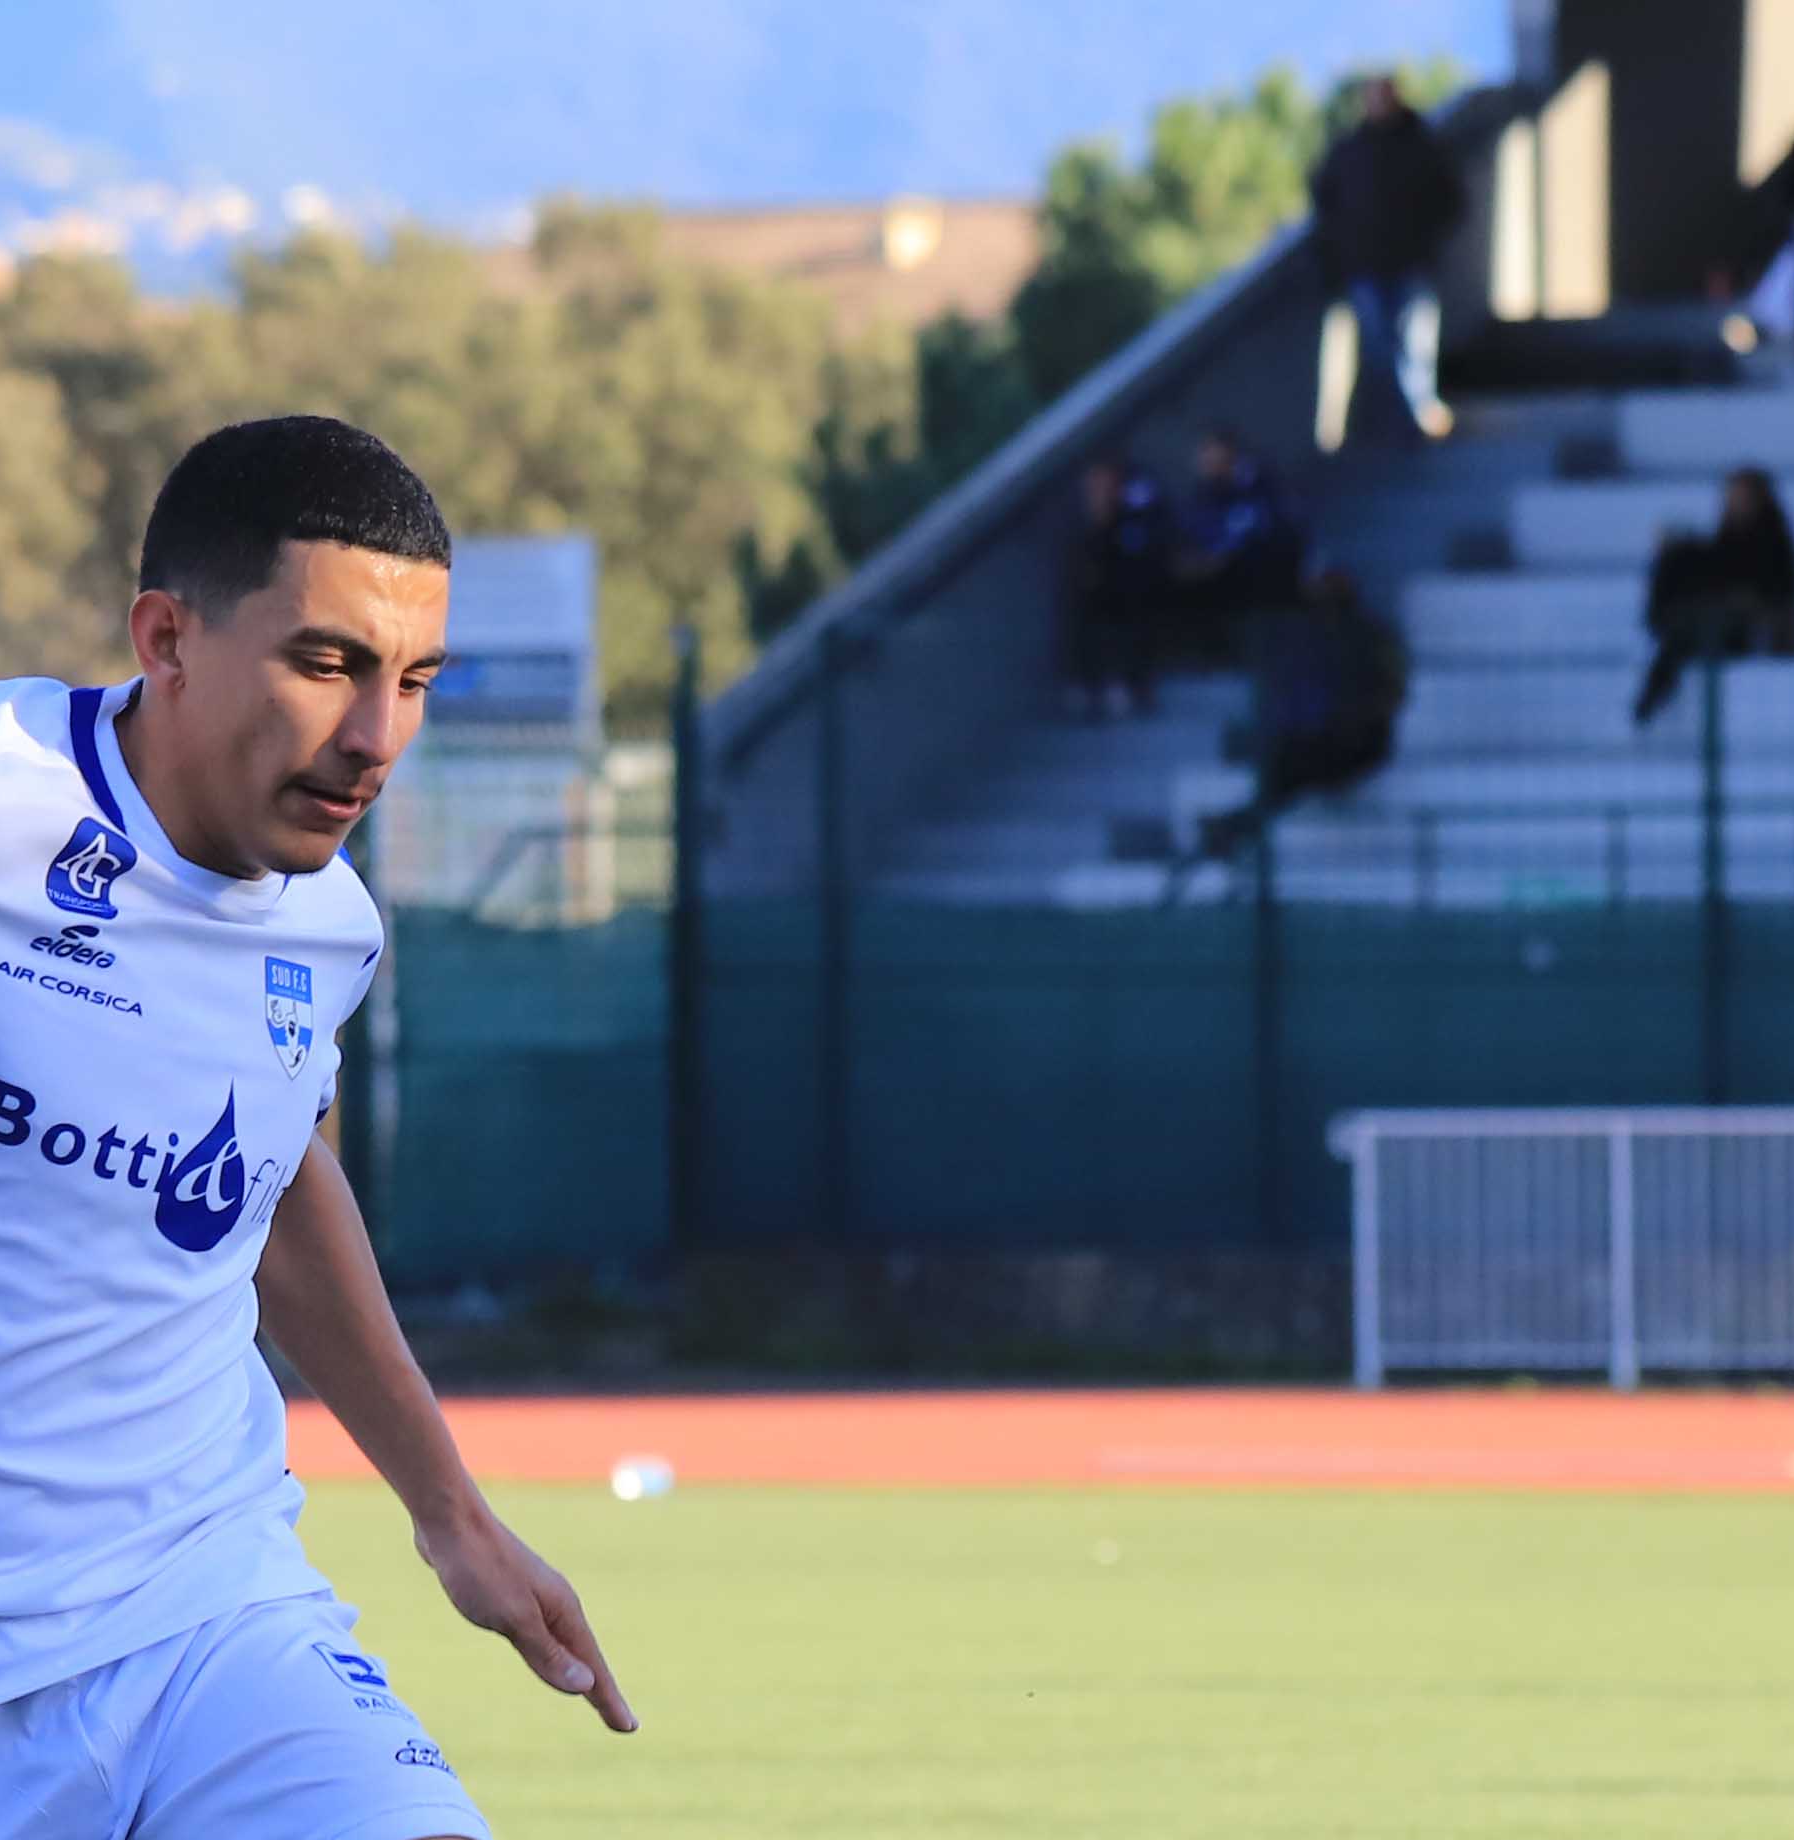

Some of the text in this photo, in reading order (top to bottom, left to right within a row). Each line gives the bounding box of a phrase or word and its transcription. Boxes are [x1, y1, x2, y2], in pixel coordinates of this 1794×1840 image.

[39, 975, 143, 1017] CORSICA
[271, 964, 291, 988] SUD
[241, 1158, 289, 1224] fil
